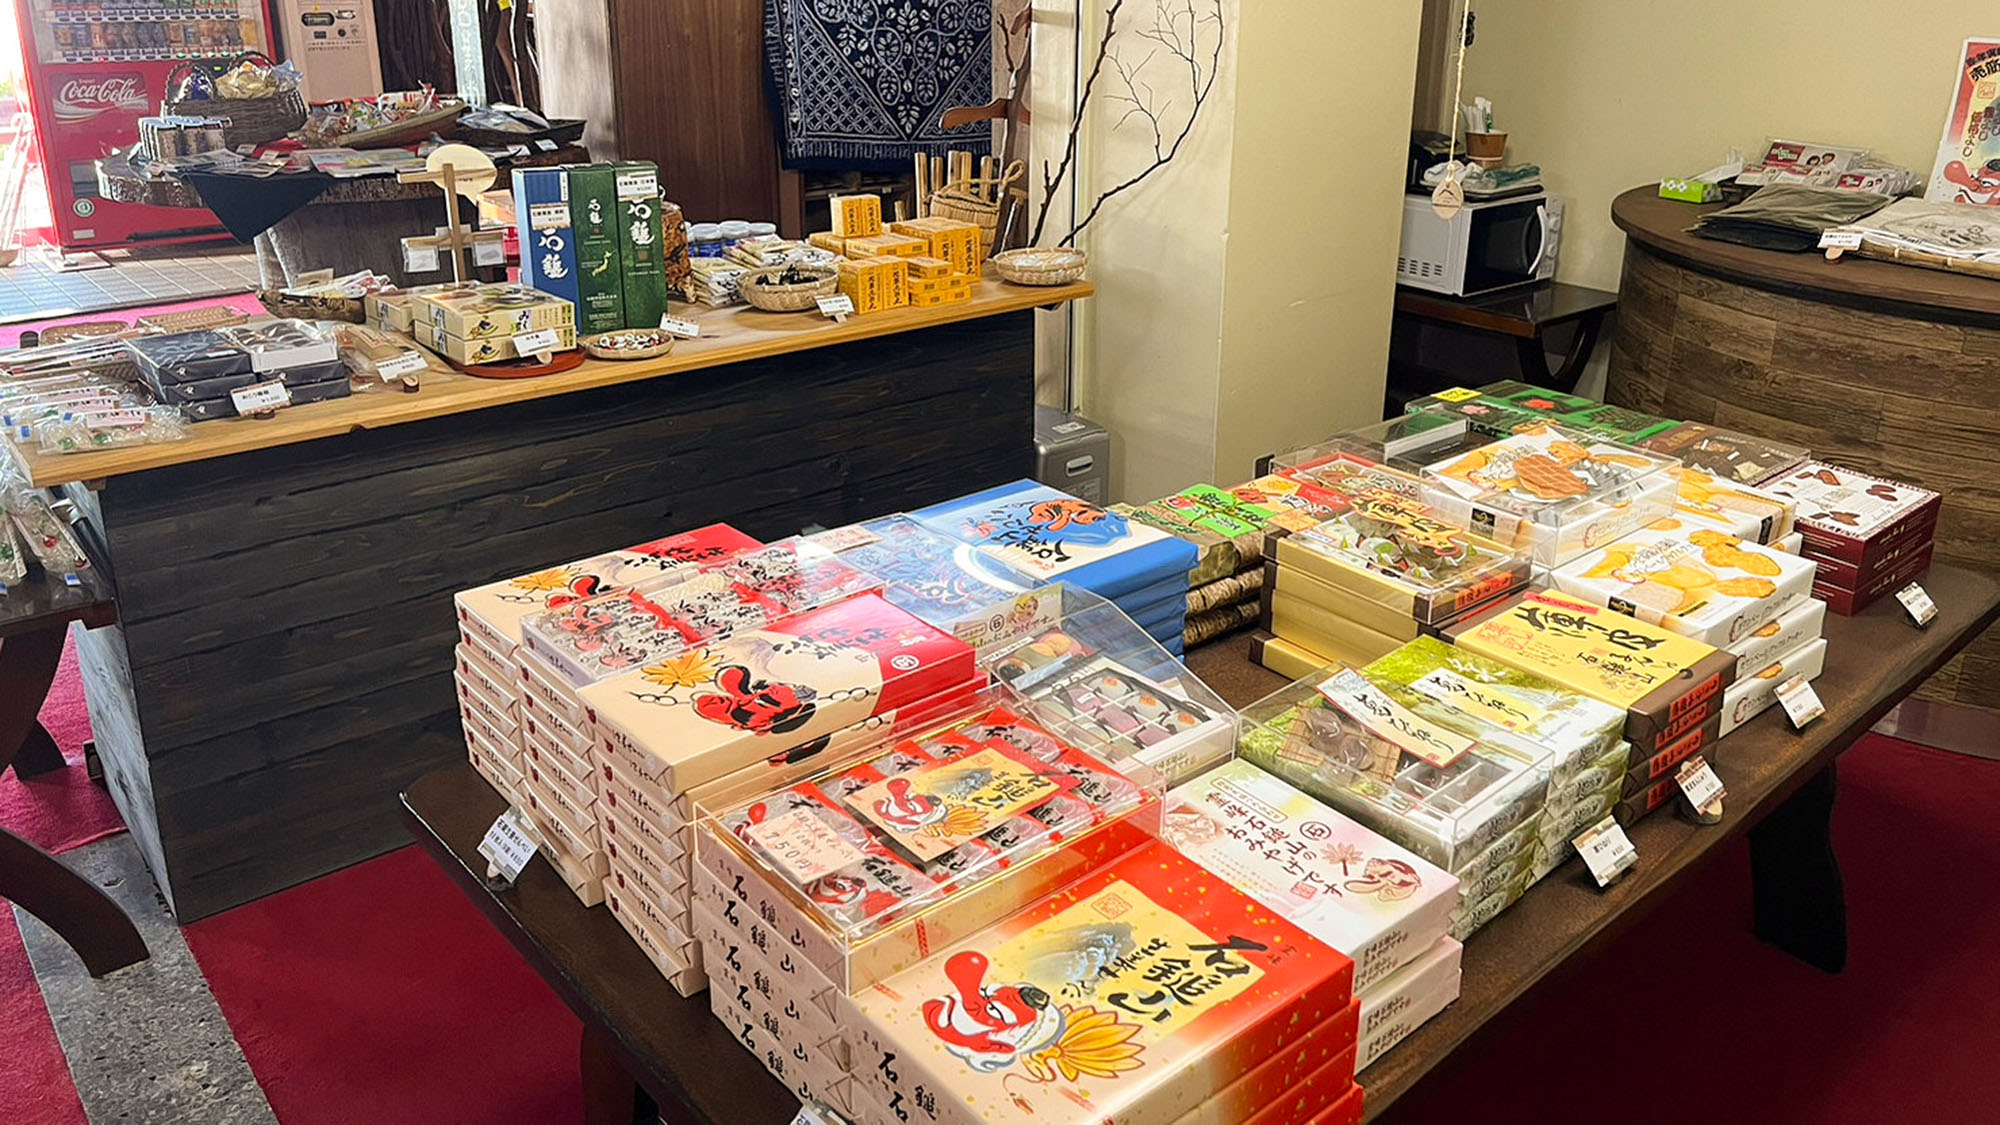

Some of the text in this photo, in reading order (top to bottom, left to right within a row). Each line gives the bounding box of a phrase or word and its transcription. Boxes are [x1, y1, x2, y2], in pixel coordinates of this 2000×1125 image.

[1513, 604, 1667, 651] 薄皮
[1205, 791, 1318, 862] 霊峰石鎚山の
[1225, 825, 1344, 898] おみやげです
[1108, 935, 1269, 1023] 石鎚山
